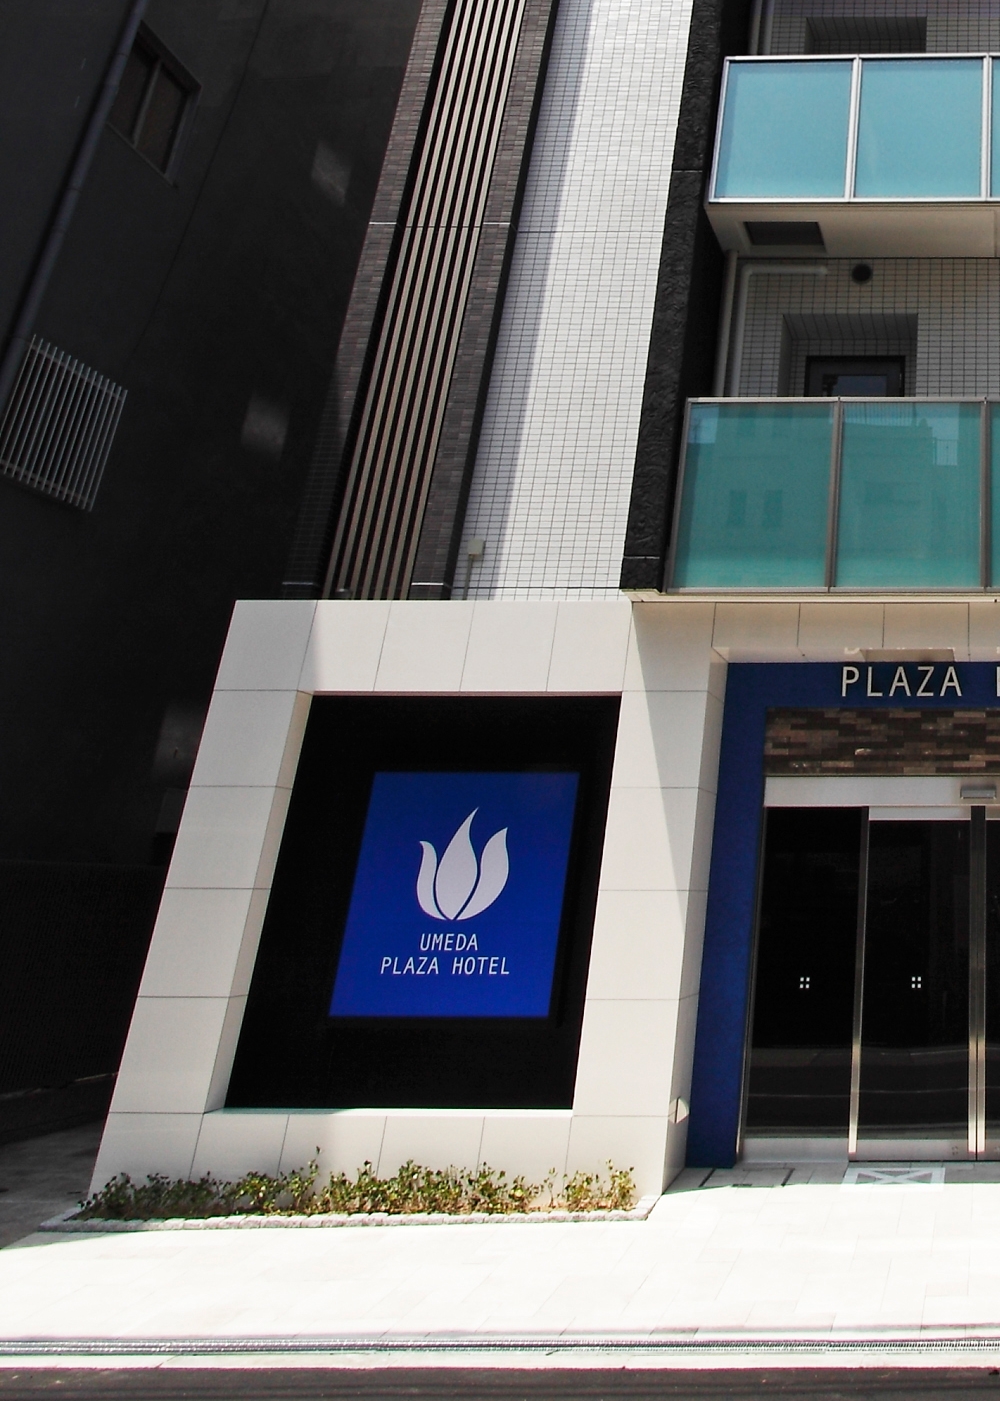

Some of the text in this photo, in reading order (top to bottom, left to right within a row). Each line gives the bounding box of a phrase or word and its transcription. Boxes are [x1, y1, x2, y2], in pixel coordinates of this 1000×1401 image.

[841, 665, 963, 697] PLAZA
[420, 933, 479, 951] UMEDA
[380, 956, 510, 975] PLAZA HOTEL
